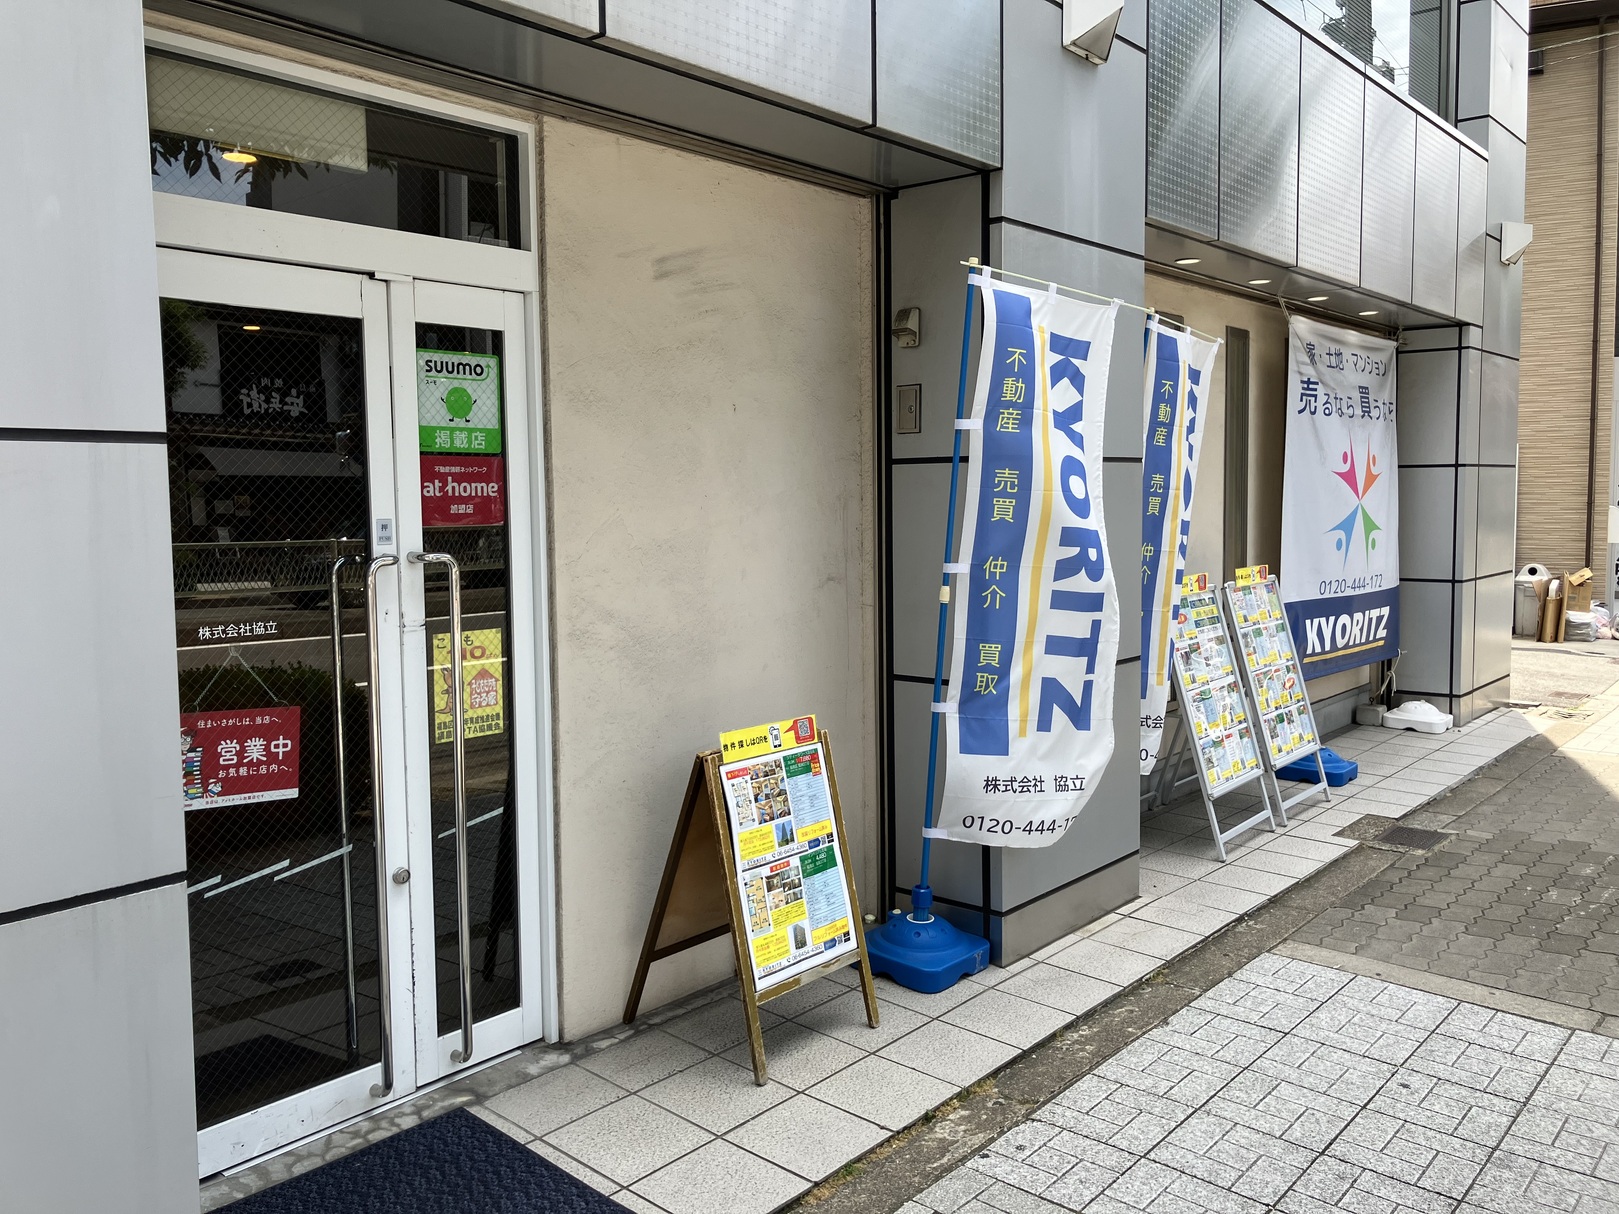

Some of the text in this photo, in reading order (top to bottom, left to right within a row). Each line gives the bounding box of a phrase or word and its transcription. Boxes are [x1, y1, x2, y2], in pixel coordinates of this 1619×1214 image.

[1306, 341, 1387, 377] 家・土地・マンション
[1297, 377, 1355, 419] 売るなら
[1153, 380, 1174, 447] 不動産
[434, 430, 487, 449] 掲載店
[422, 476, 499, 497] at home
[1146, 473, 1165, 516] 売買
[450, 504, 474, 513] 加盟店
[380, 523, 389, 532] 押
[973, 347, 1027, 695] 不動産 売買 仲介 買取
[1036, 331, 1105, 733] KYORITZ
[1319, 574, 1383, 596] 0120-444-172
[198, 620, 278, 641] 株式会社協立
[1305, 605, 1390, 655] KYORITZ
[436, 633, 474, 650] こも
[197, 715, 282, 729] 住まいさがしは、当店へ。
[217, 734, 292, 766] 営業中
[218, 764, 293, 778] お気軽に店内へ。
[983, 774, 1086, 794] 株式会社 協立
